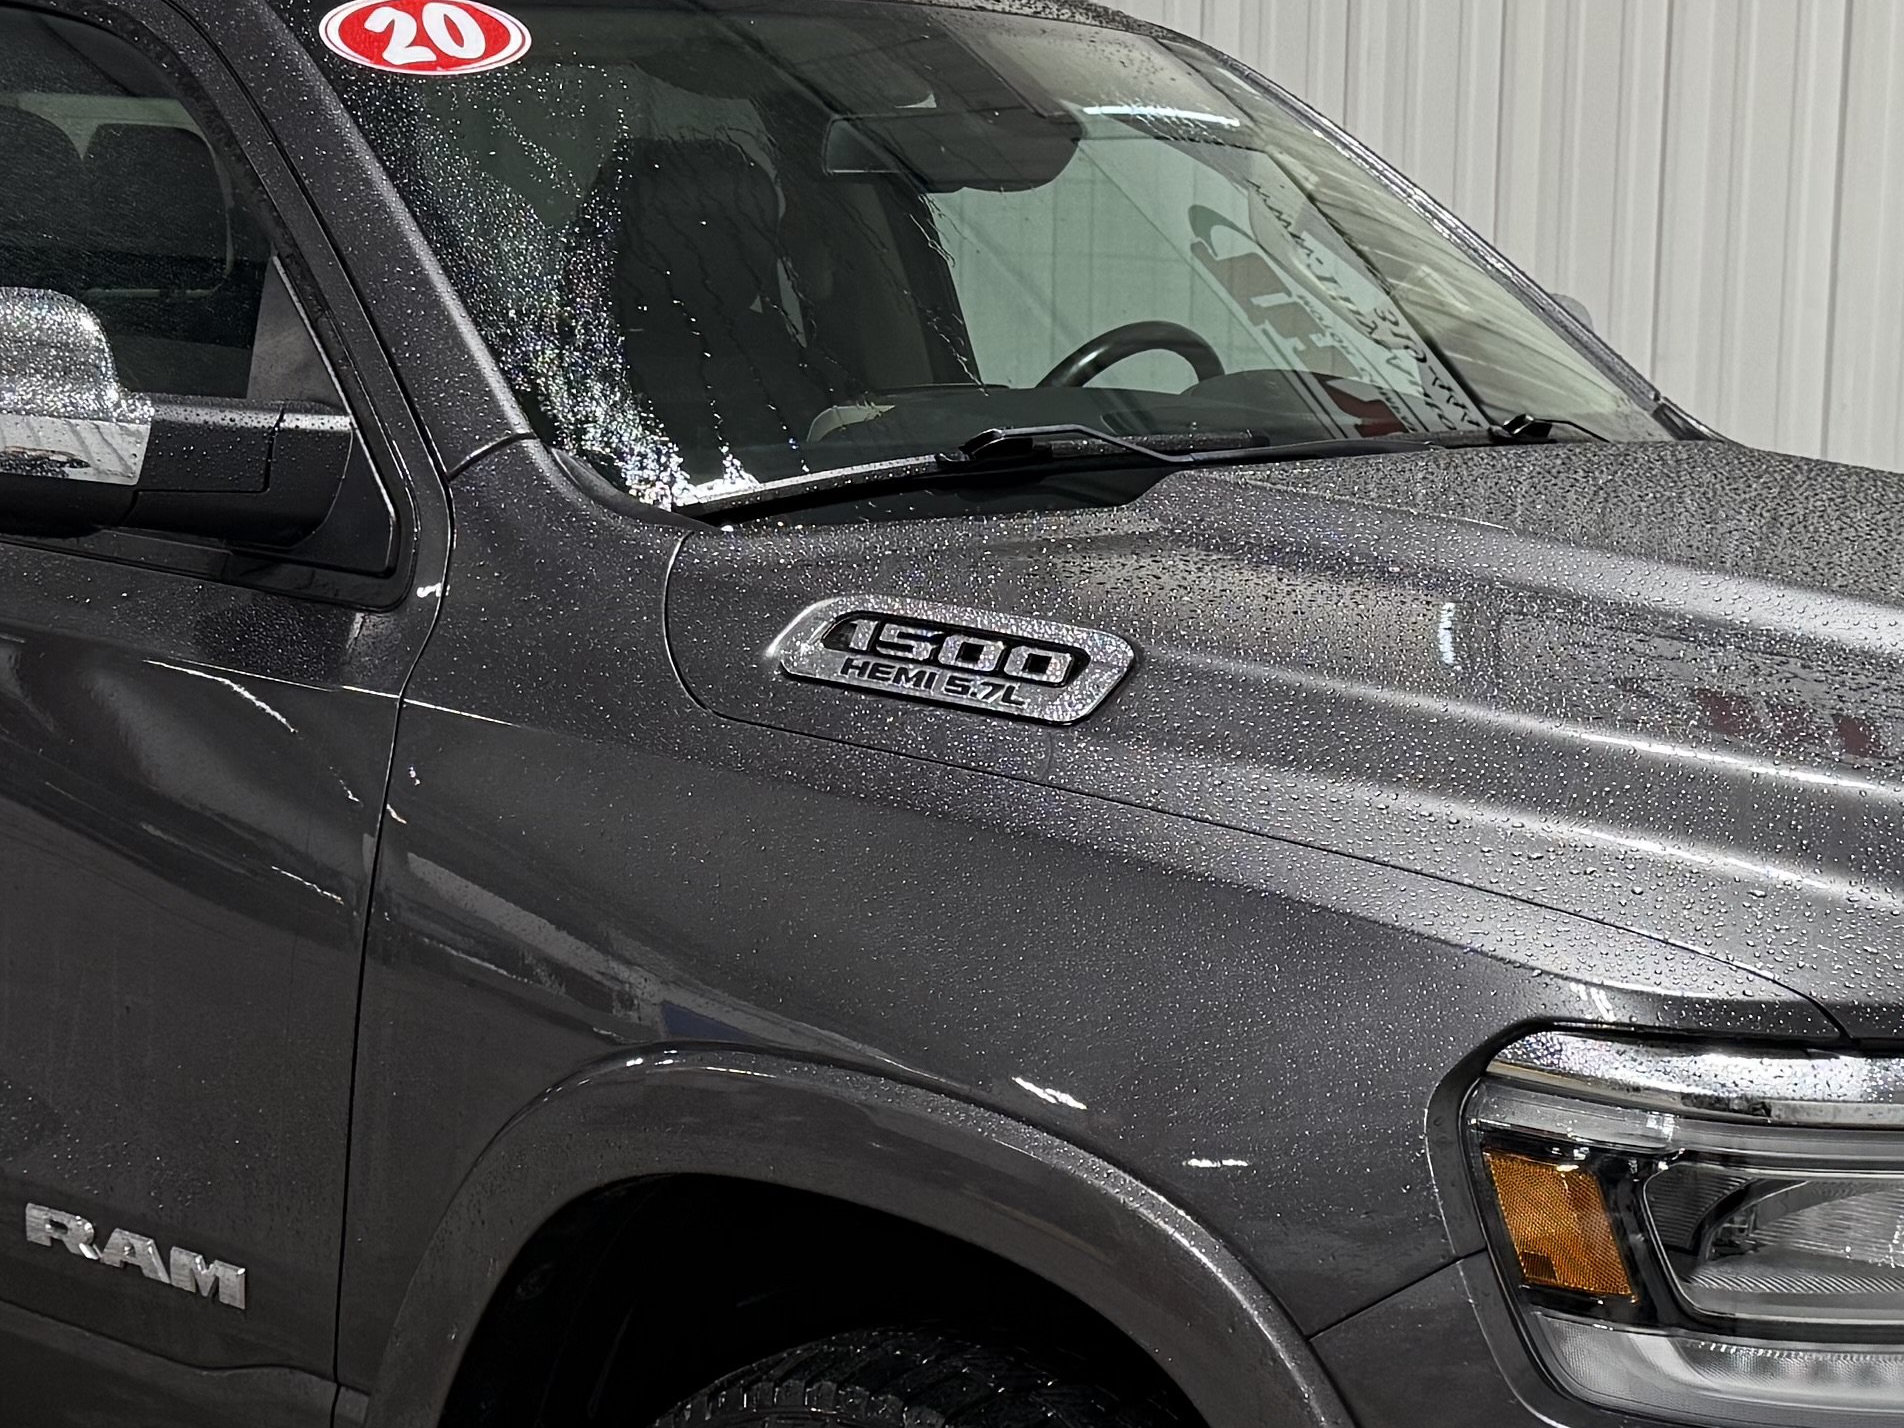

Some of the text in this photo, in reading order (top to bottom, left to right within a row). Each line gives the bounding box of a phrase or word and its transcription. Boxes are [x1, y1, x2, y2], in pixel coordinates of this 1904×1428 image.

[363, 1, 486, 66] 20
[841, 657, 1026, 708] HEMI 5.7L
[847, 618, 1074, 685] 1500
[25, 1202, 246, 1310] RAM
